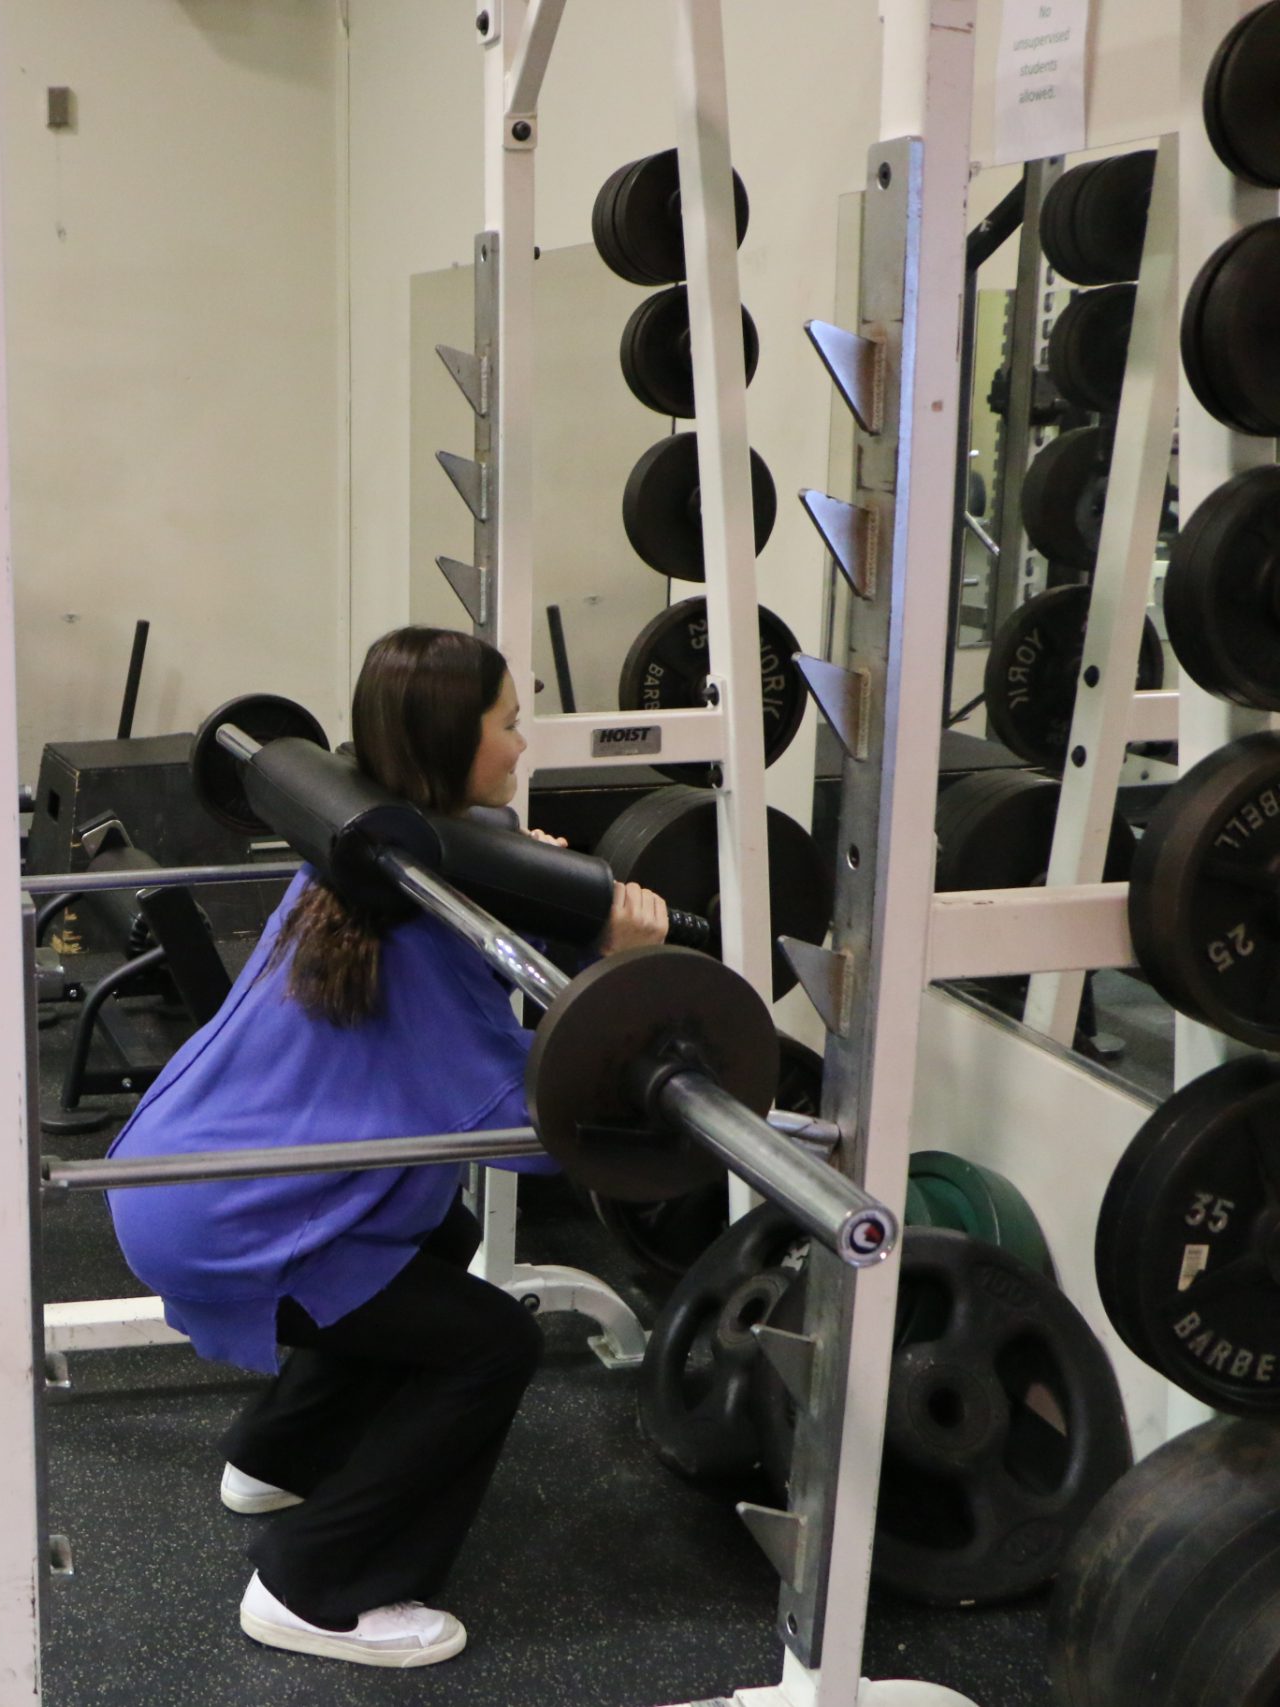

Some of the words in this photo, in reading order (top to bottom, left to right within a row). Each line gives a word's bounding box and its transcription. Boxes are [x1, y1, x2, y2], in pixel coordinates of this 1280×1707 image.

[1039, 6, 1051, 18] No
[1013, 26, 1071, 51] unsupervised
[1020, 60, 1057, 76] students
[688, 618, 709, 649] 25
[599, 727, 651, 743] HOIST
[1214, 783, 1280, 848] BELL
[1208, 923, 1255, 973] 25
[1184, 1191, 1235, 1234] 35
